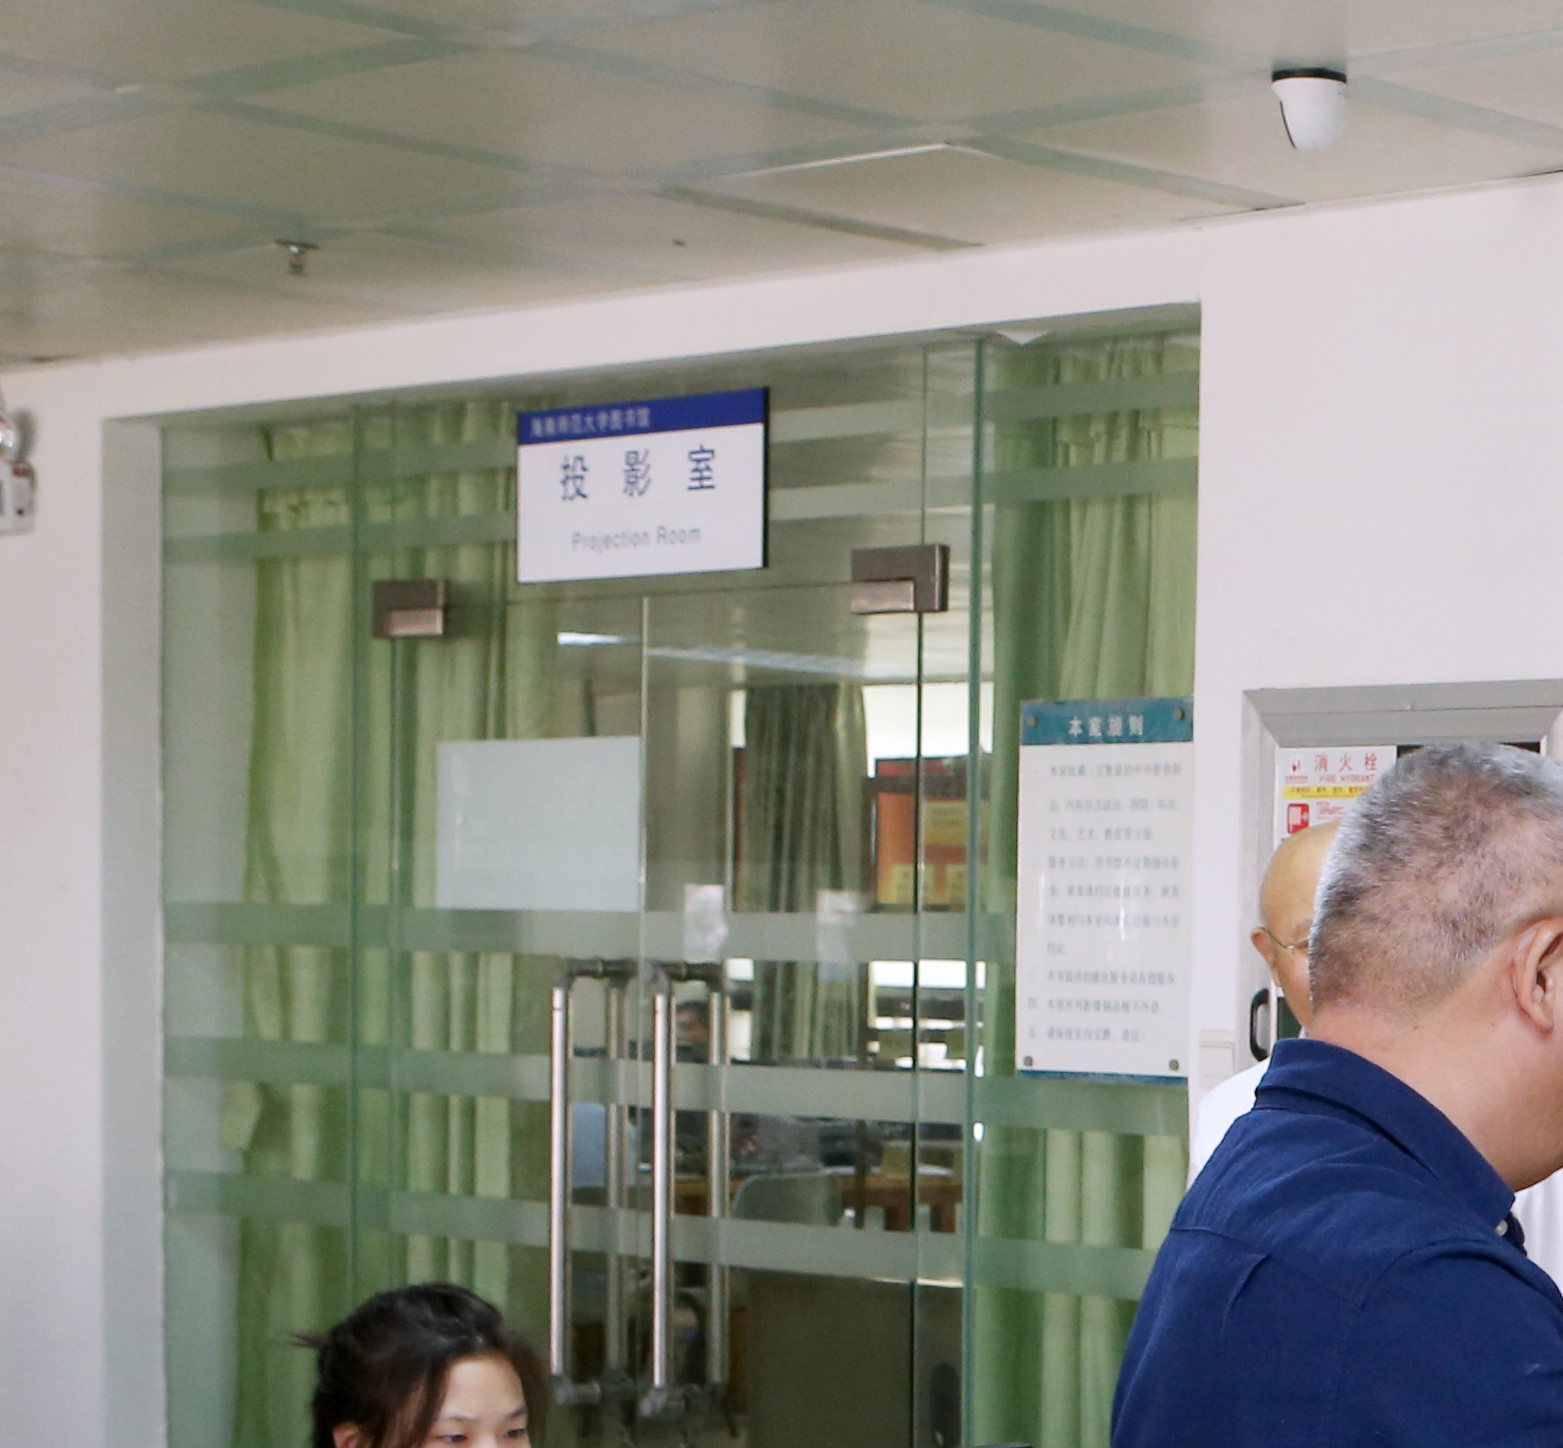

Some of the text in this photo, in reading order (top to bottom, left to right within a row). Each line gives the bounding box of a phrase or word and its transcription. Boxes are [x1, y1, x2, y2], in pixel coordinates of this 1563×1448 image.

[560, 444, 716, 502] 投影室
[572, 525, 701, 554] Projection Room
[1067, 715, 1144, 738] 本室规则
[1313, 752, 1378, 773] 消火栓
